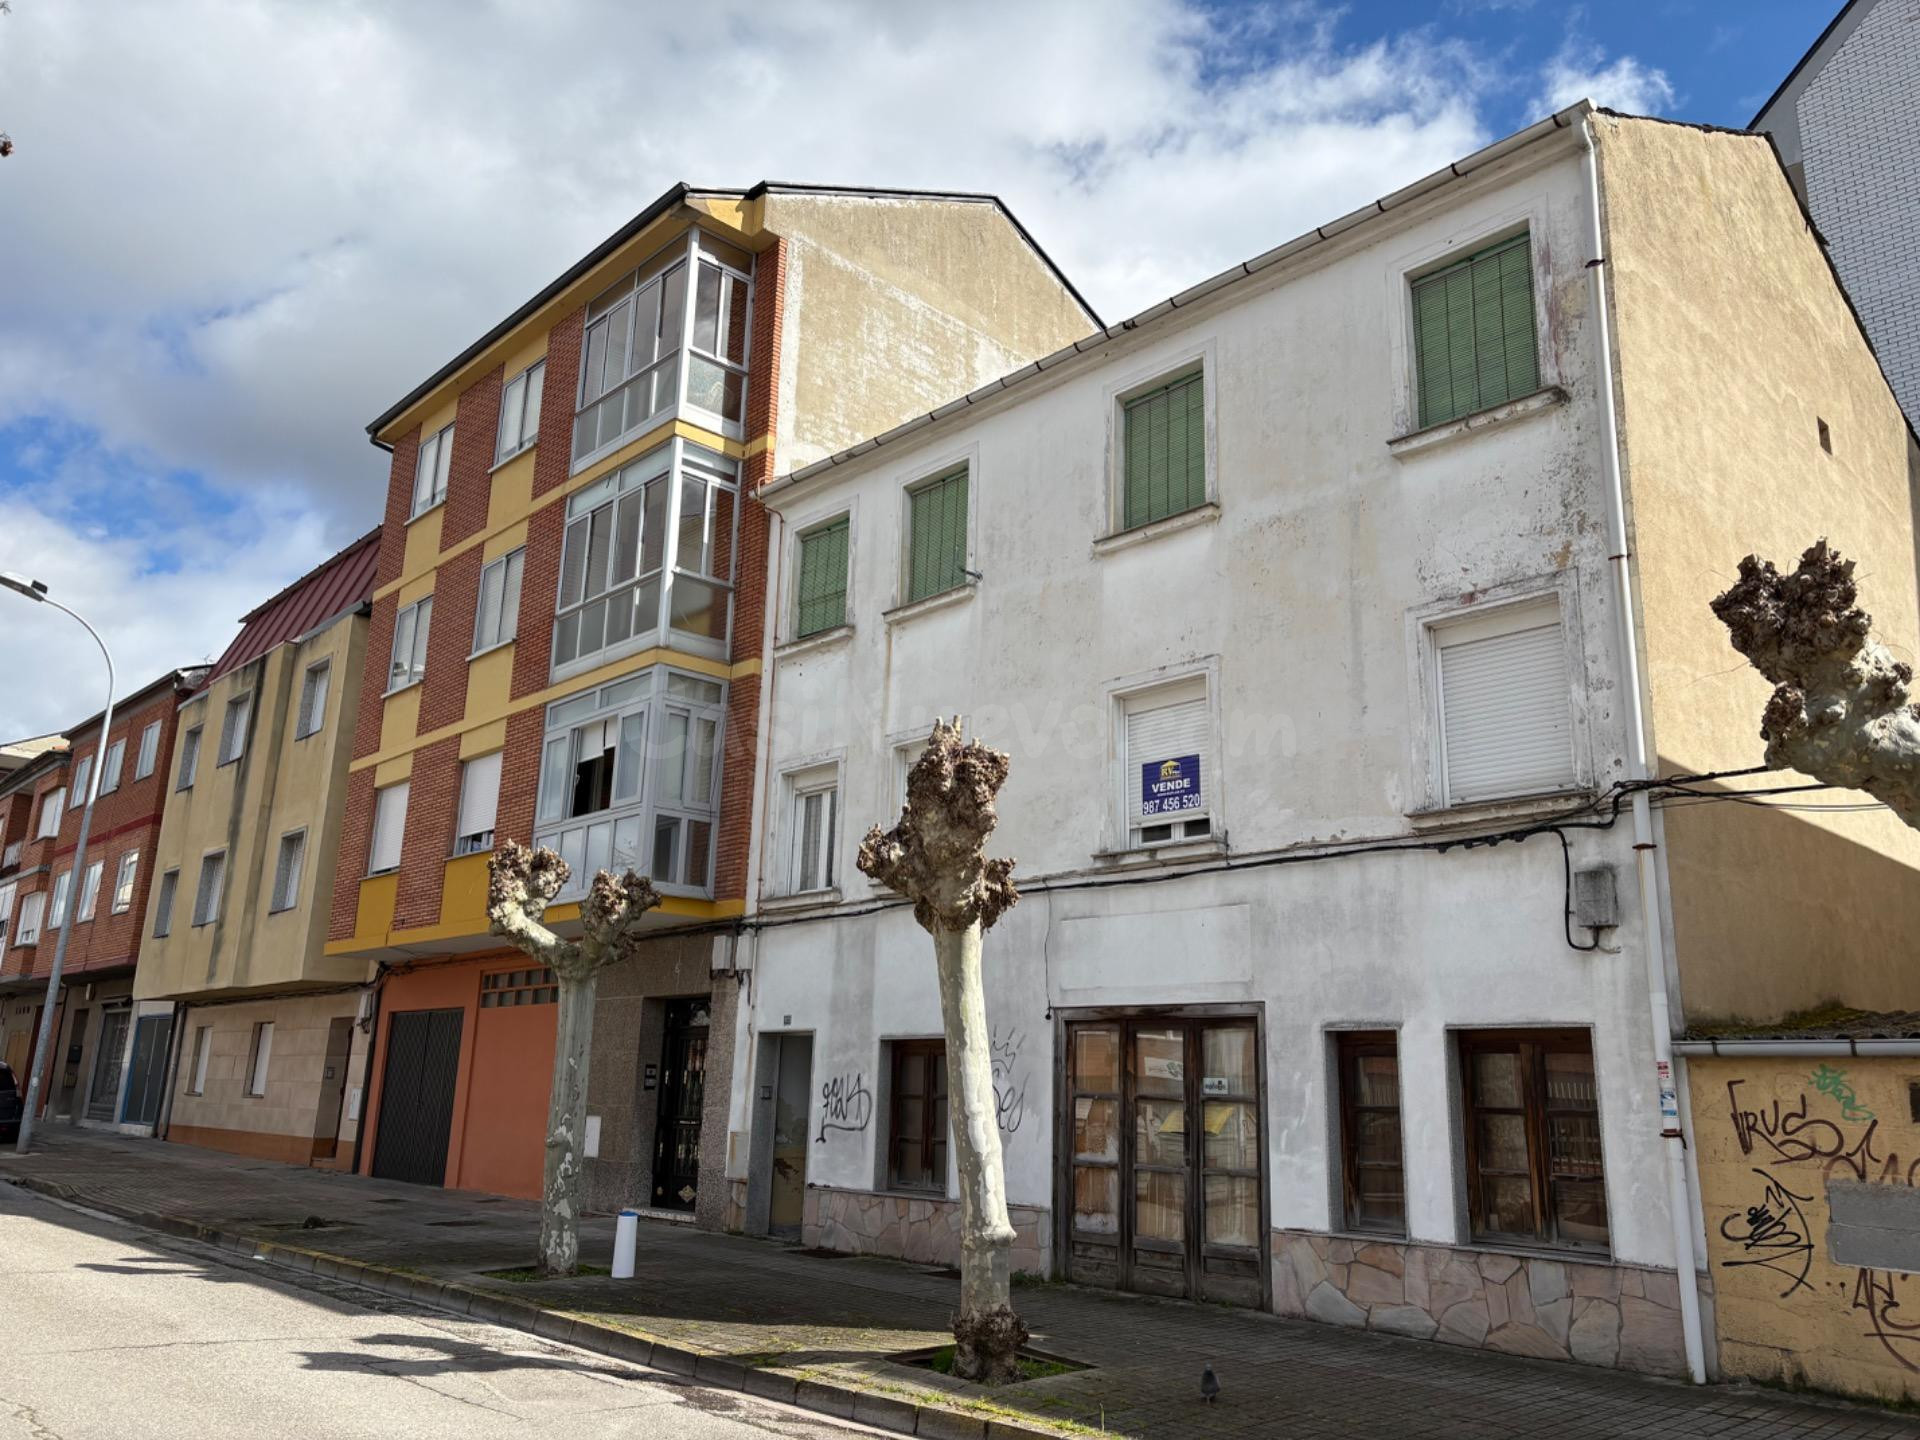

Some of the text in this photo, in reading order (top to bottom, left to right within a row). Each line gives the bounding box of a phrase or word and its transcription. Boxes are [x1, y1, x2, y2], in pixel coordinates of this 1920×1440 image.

[1151, 778, 1191, 793] VENDE
[1143, 794, 1200, 815] 987 456 520
